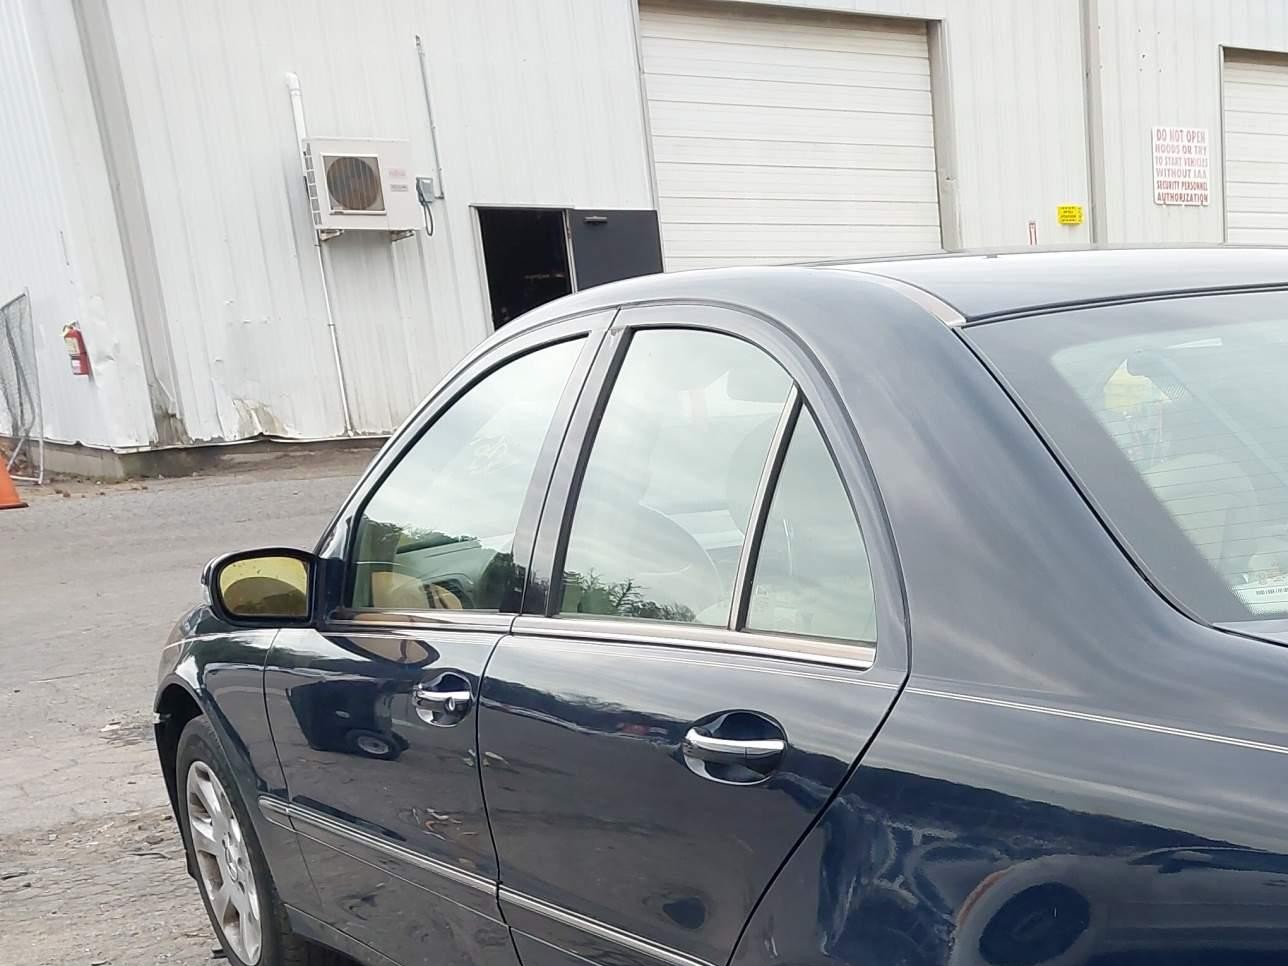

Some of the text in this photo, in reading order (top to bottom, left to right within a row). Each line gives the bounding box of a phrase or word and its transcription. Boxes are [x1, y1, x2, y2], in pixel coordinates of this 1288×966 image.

[1156, 128, 1206, 144] DO NOT OPEN
[1155, 144, 1207, 156] HOODS OR TRY
[1155, 156, 1208, 167] TO START VEHICLES
[1156, 168, 1191, 178] WITHOUT
[1157, 180, 1208, 191] SECURITY PERSONNEL
[1157, 192, 1208, 203] AUTHORIZATION
